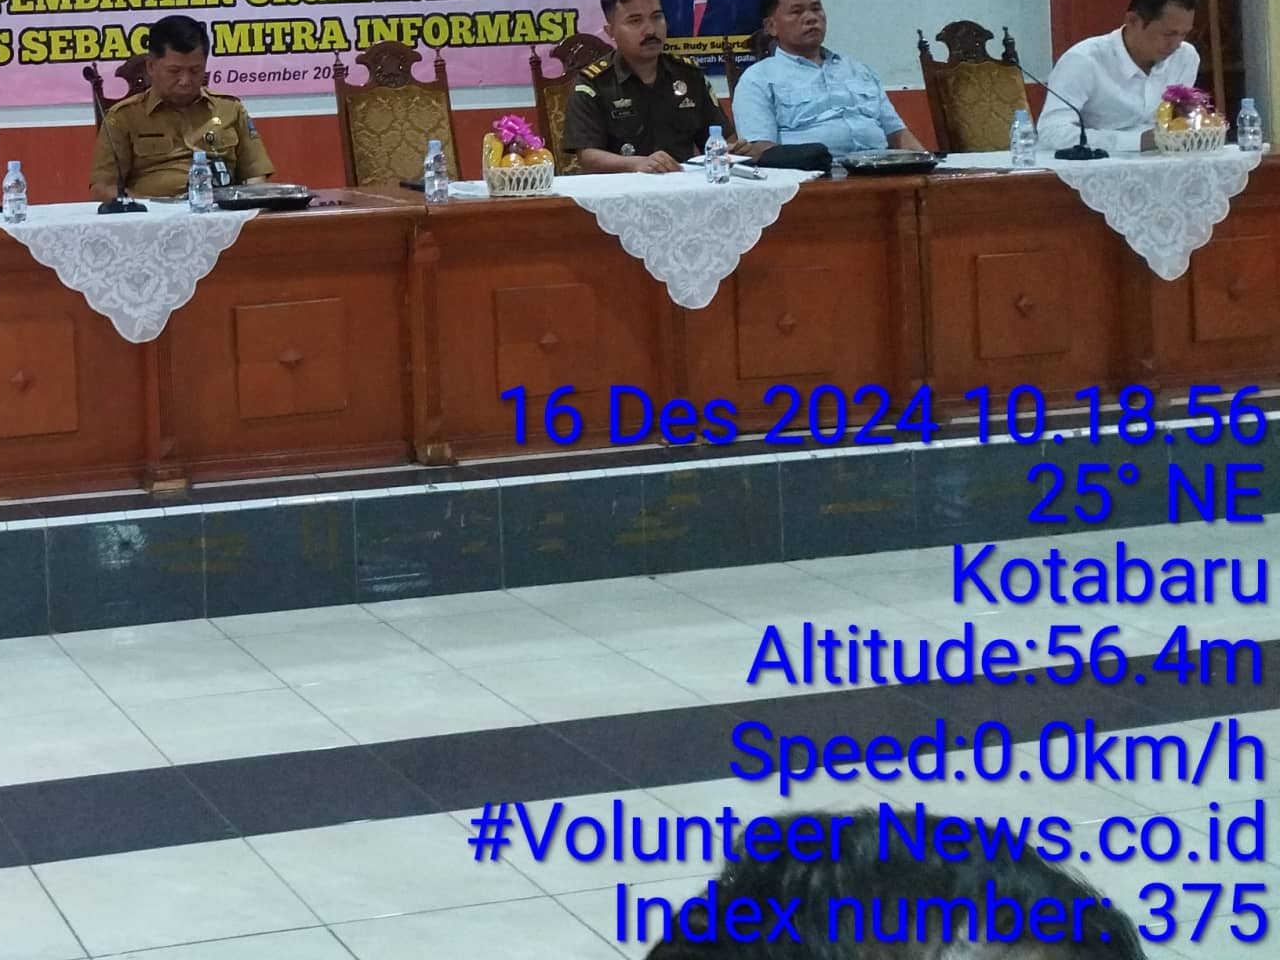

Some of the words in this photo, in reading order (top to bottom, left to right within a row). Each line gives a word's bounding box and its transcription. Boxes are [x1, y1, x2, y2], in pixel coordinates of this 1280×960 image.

[212, 15, 351, 56] MITRA
[354, 8, 579, 50] INFORMASI
[683, 41, 707, 51] Rudy
[227, 67, 308, 84] Desember
[313, 65, 349, 80] 204
